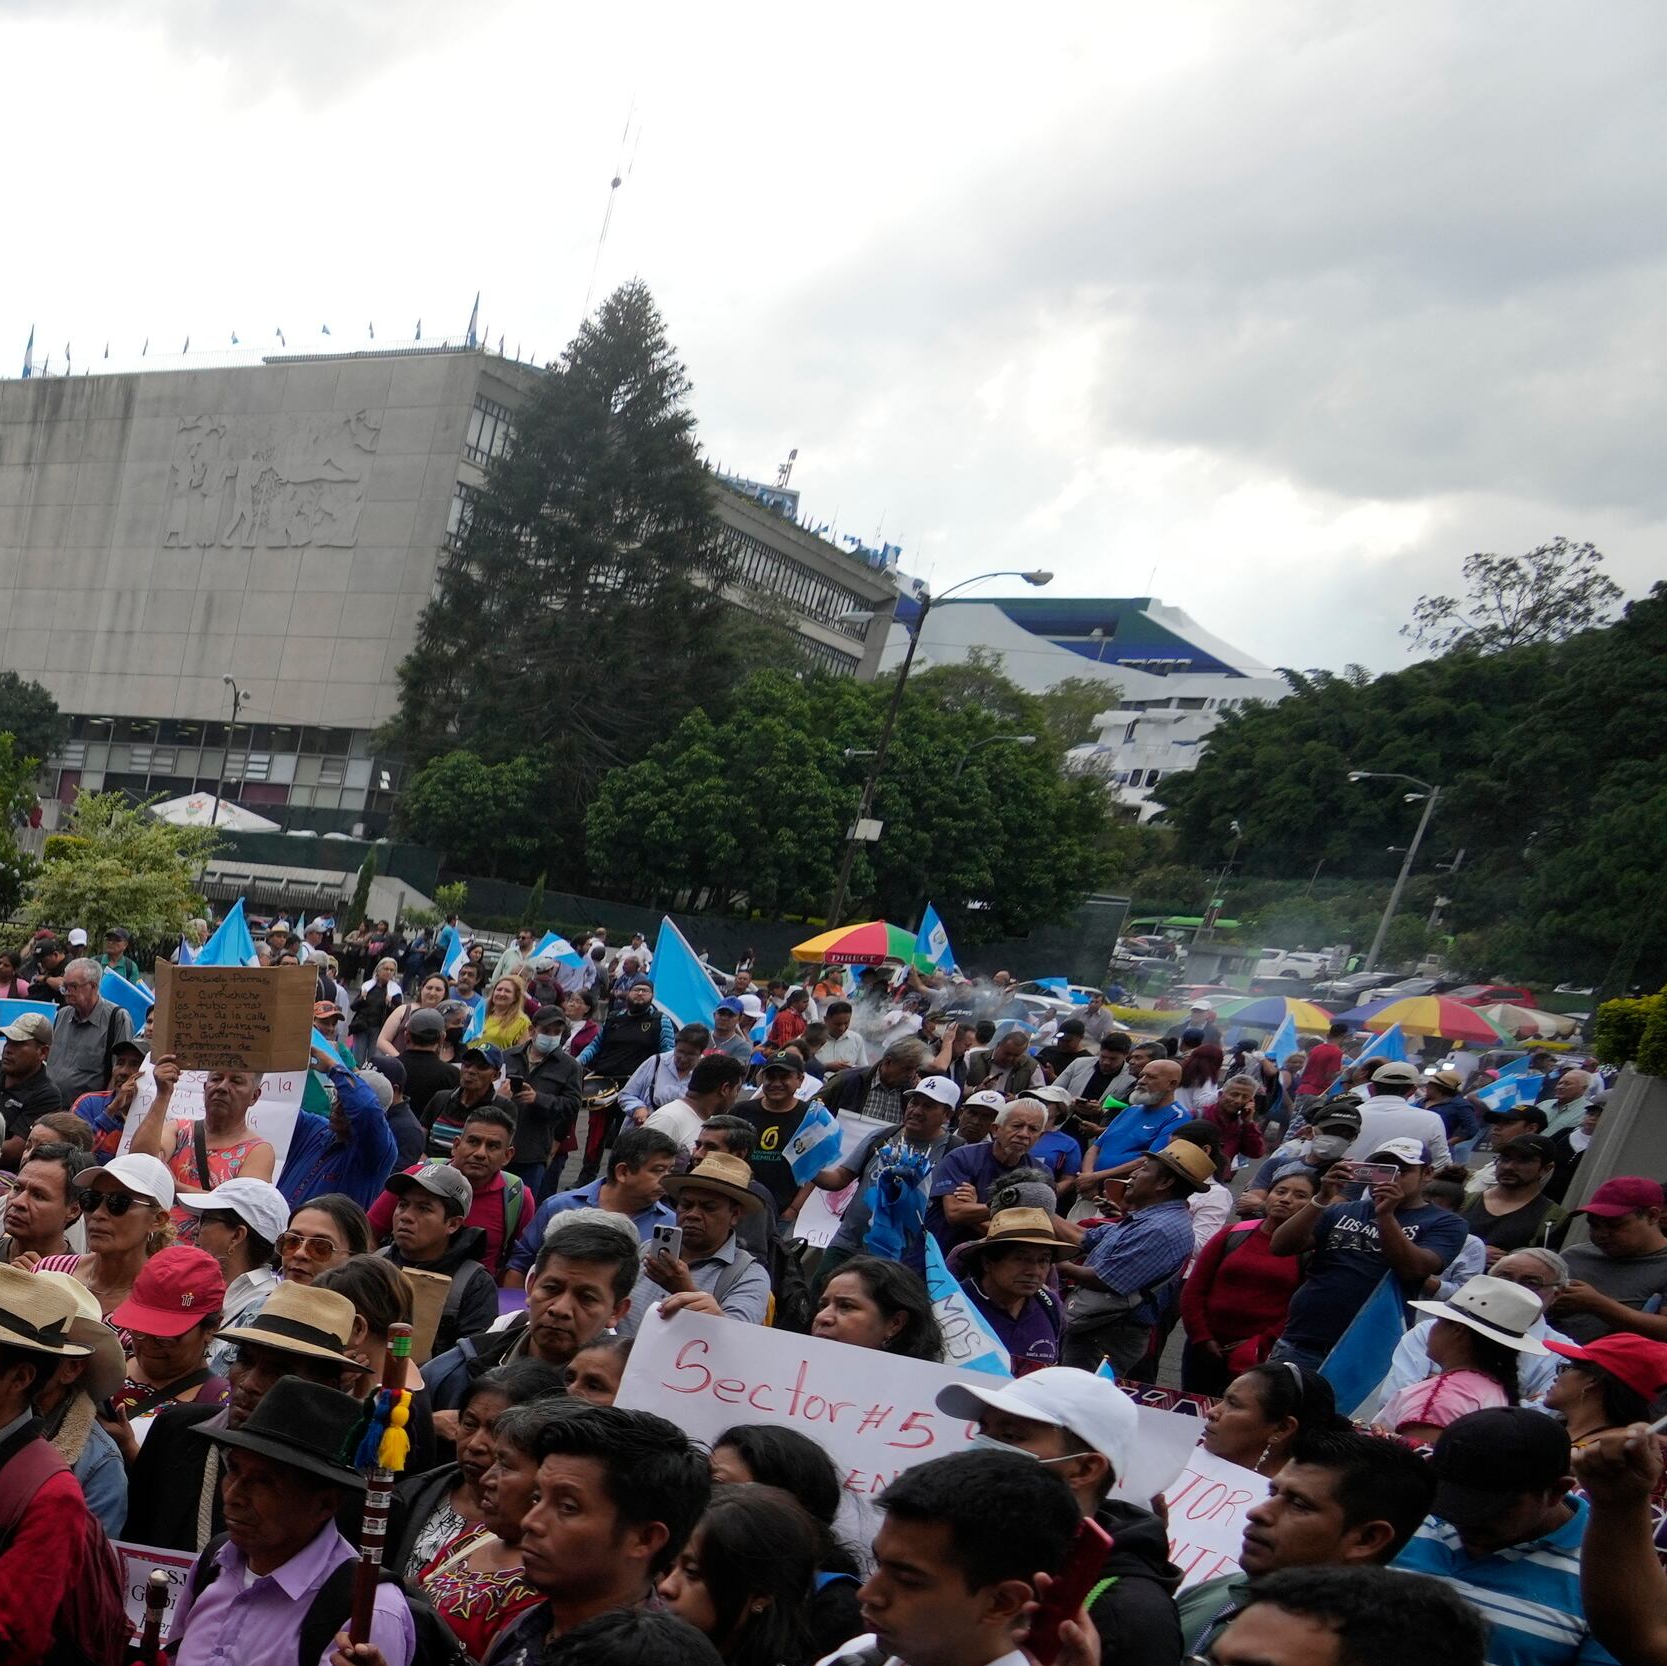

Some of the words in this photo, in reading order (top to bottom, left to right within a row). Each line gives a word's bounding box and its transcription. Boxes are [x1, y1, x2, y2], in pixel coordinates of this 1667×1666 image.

[1333, 1214, 1362, 1232] LOS
[1359, 1223, 1420, 1241] ANES
[661, 1339, 857, 1424] Sector
